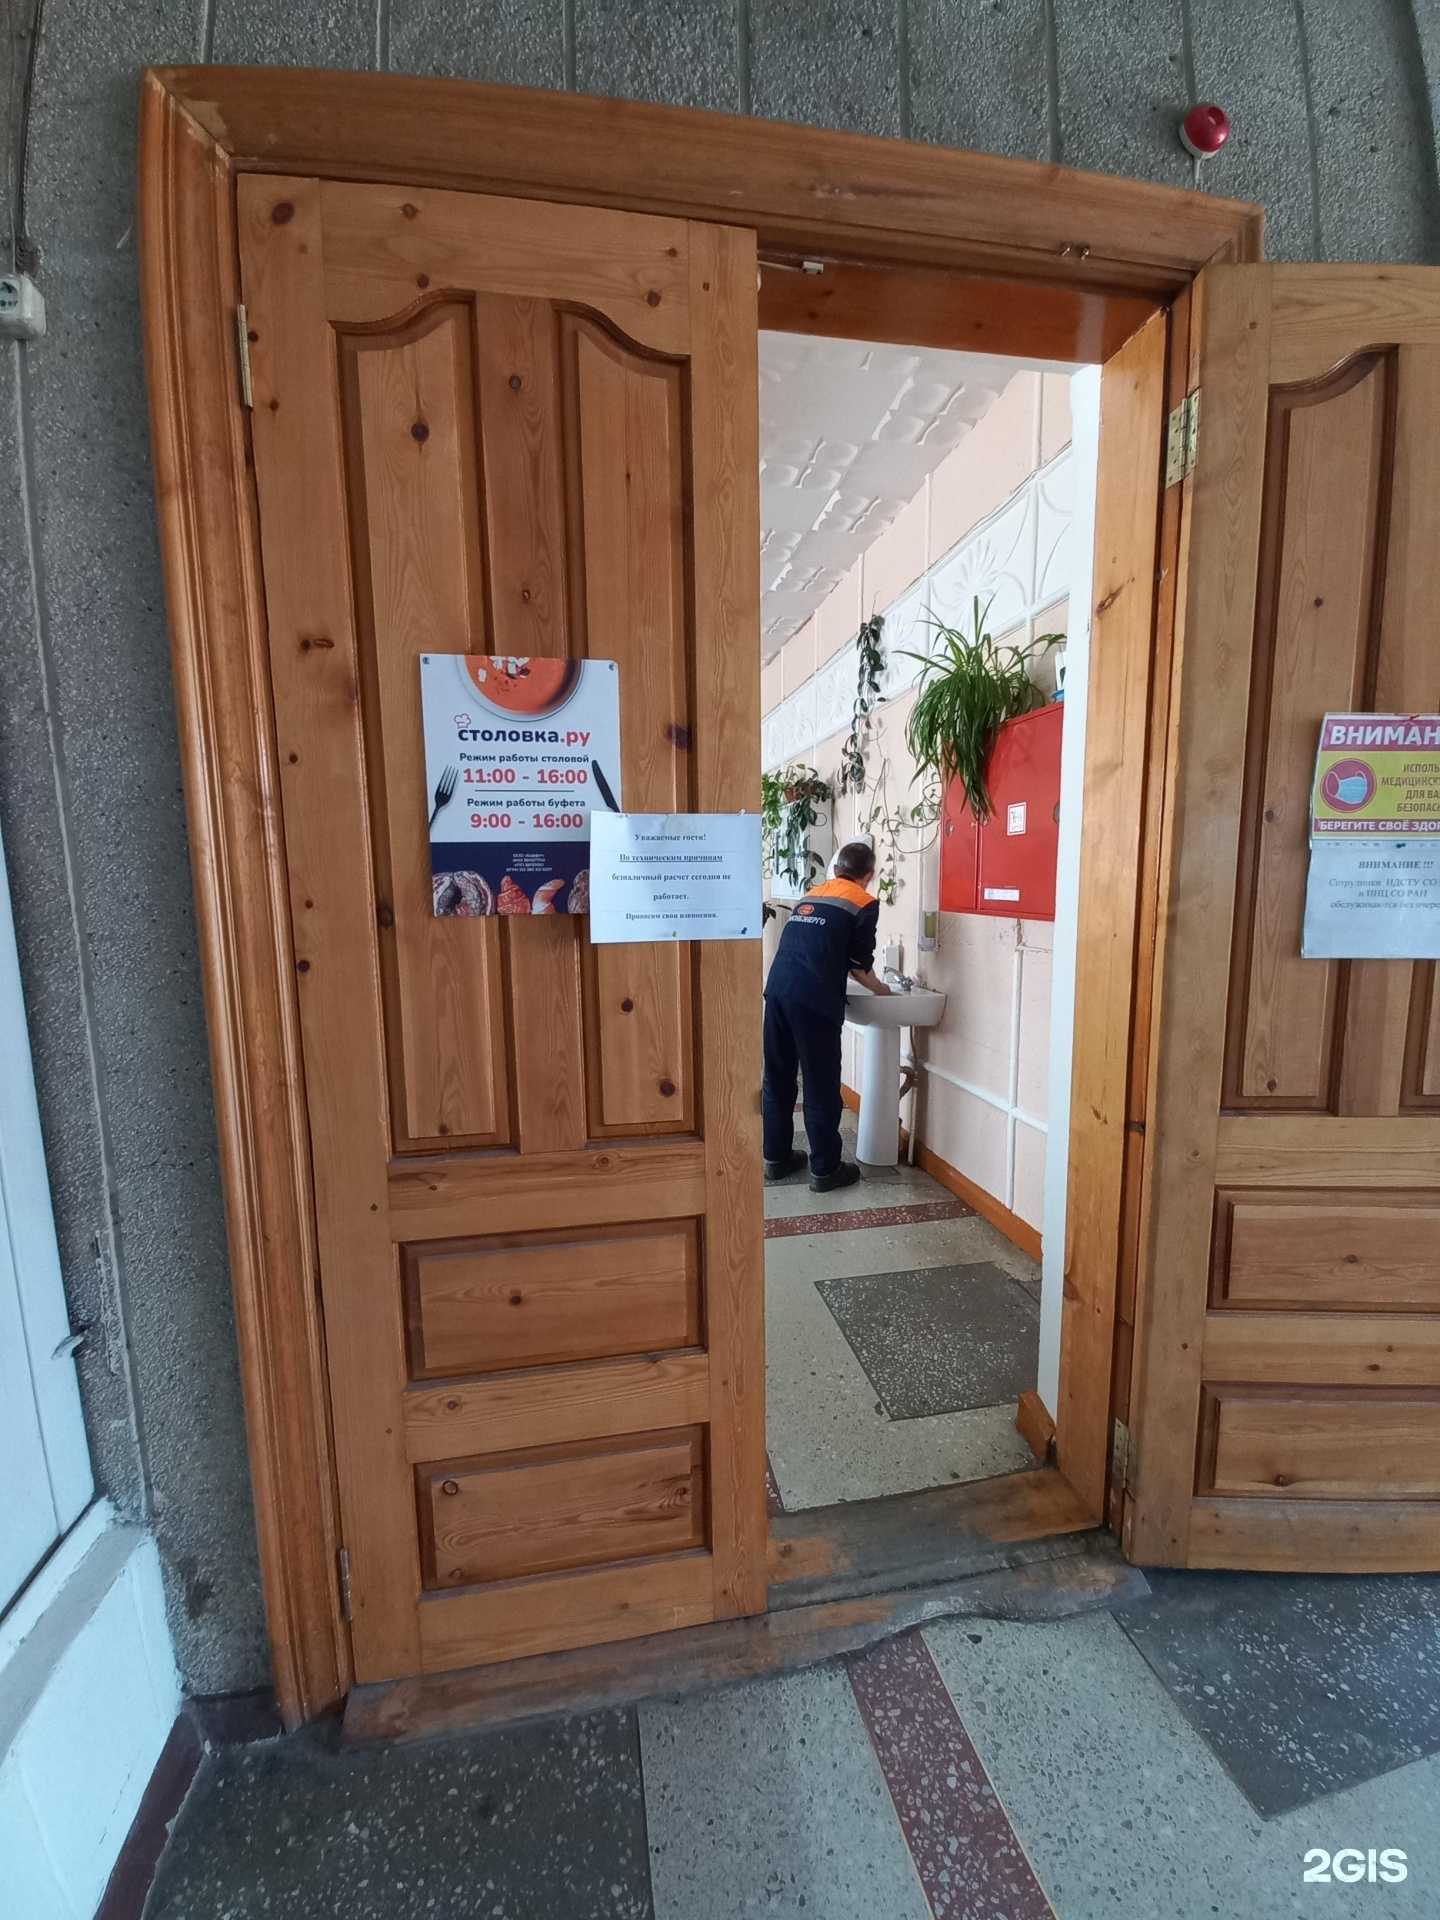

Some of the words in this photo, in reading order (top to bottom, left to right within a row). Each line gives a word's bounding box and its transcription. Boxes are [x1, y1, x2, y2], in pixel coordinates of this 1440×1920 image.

[458, 729, 591, 747] столовка.ру
[1330, 726, 1440, 745] ВНИМАН
[459, 753, 496, 762] Режим
[499, 753, 538, 764] работы
[541, 754, 589, 763] столовой
[463, 768, 516, 784] 11:00
[537, 769, 588, 784] 16:00
[1405, 789, 1425, 800] ДЛЯ
[1427, 789, 1440, 799] ВА
[467, 798, 503, 807] Режим
[506, 798, 545, 808] работы
[548, 798, 586, 808] буфета
[470, 813, 512, 828] 9:00
[532, 813, 583, 828] 16:00
[1320, 821, 1376, 830] БЕРЕГИТЕ
[619, 854, 630, 862] По
[611, 873, 662, 881] безналичный
[663, 873, 689, 882] расчет
[653, 892, 689, 901] работает.
